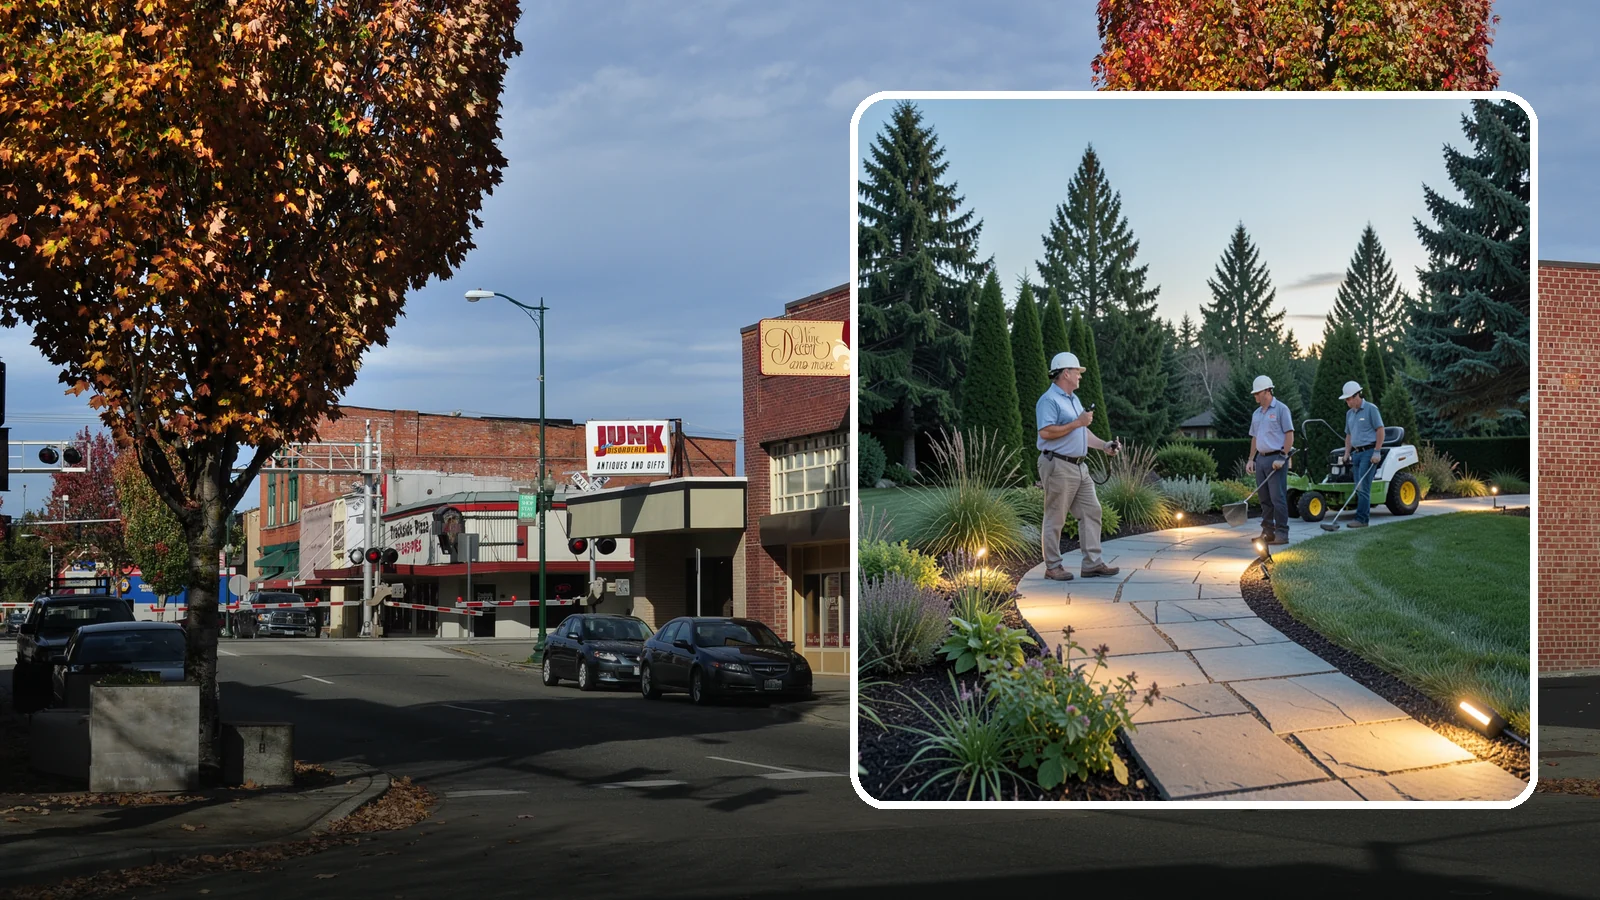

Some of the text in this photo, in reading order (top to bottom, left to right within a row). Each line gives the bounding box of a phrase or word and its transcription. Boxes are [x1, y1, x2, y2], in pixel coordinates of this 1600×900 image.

[595, 425, 665, 457] JUNK
[607, 446, 646, 454] DISORDERLY
[597, 460, 665, 470] ANTIQUES AND GIFTS
[390, 519, 429, 539] Trackside Pizza
